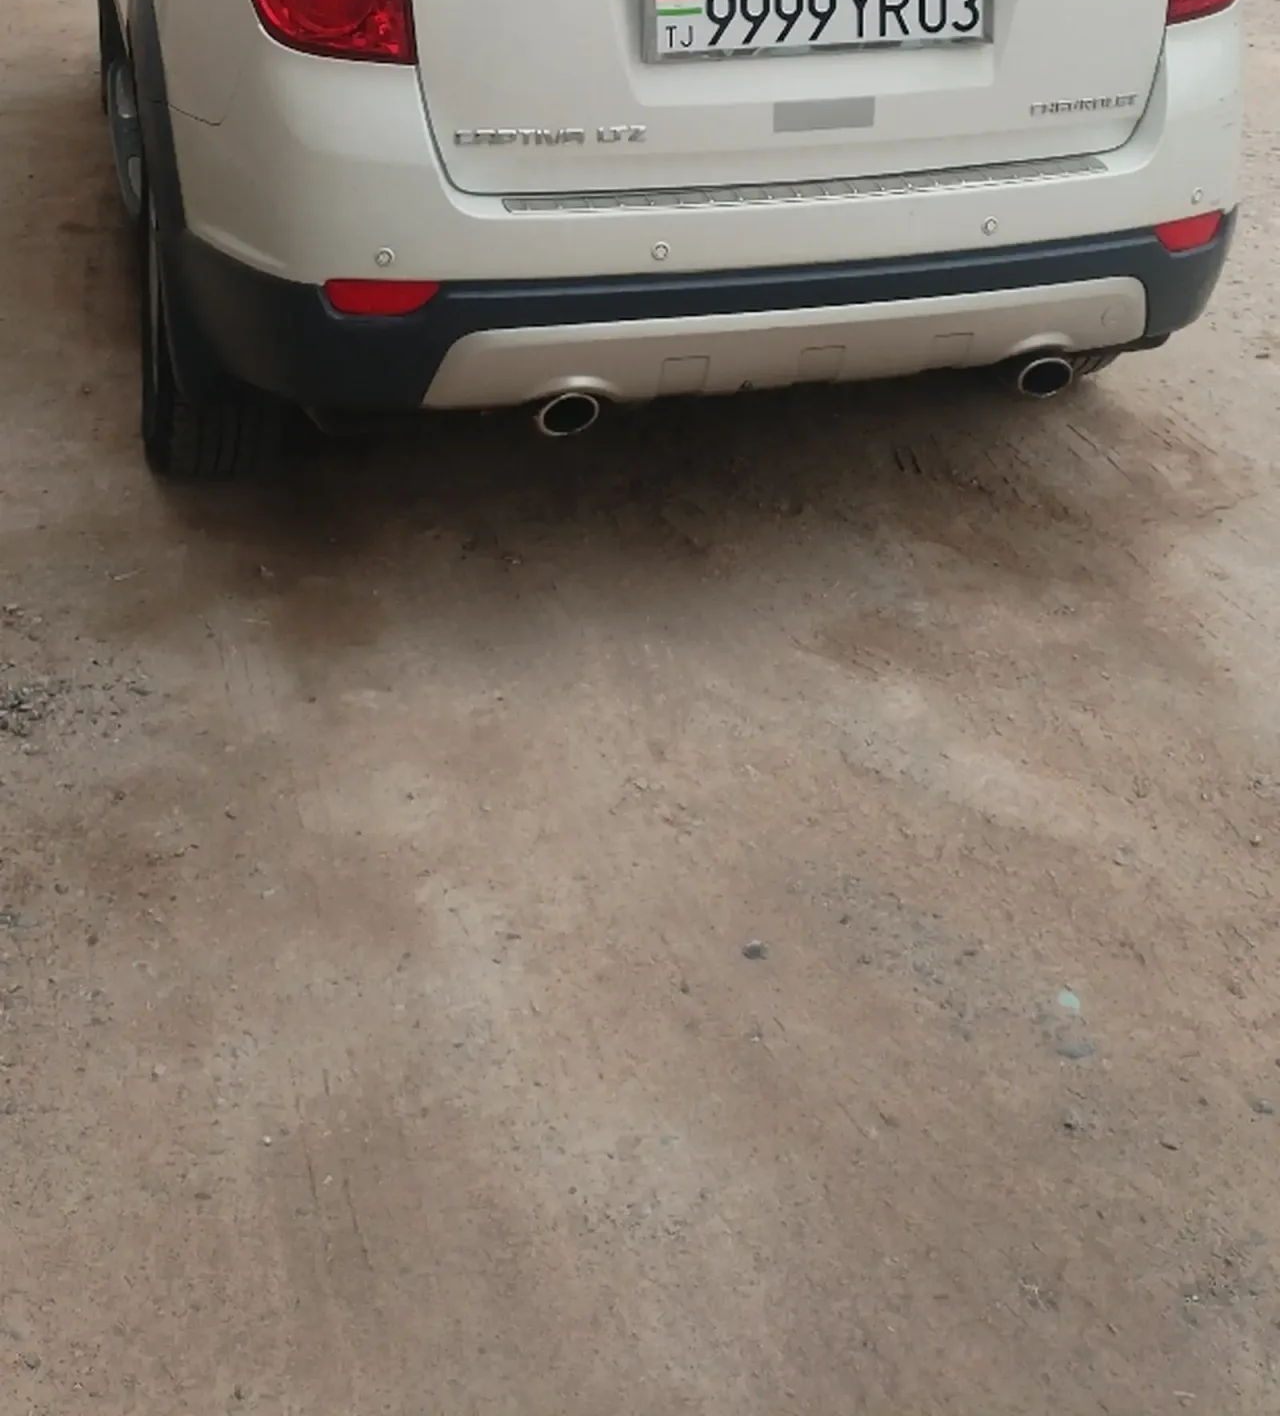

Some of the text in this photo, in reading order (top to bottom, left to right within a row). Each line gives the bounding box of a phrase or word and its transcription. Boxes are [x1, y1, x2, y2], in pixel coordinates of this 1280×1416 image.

[665, 25, 694, 49] TJ
[1029, 91, 1139, 116] CHEVROLET
[453, 124, 648, 147] CAPTIVA LTZ
